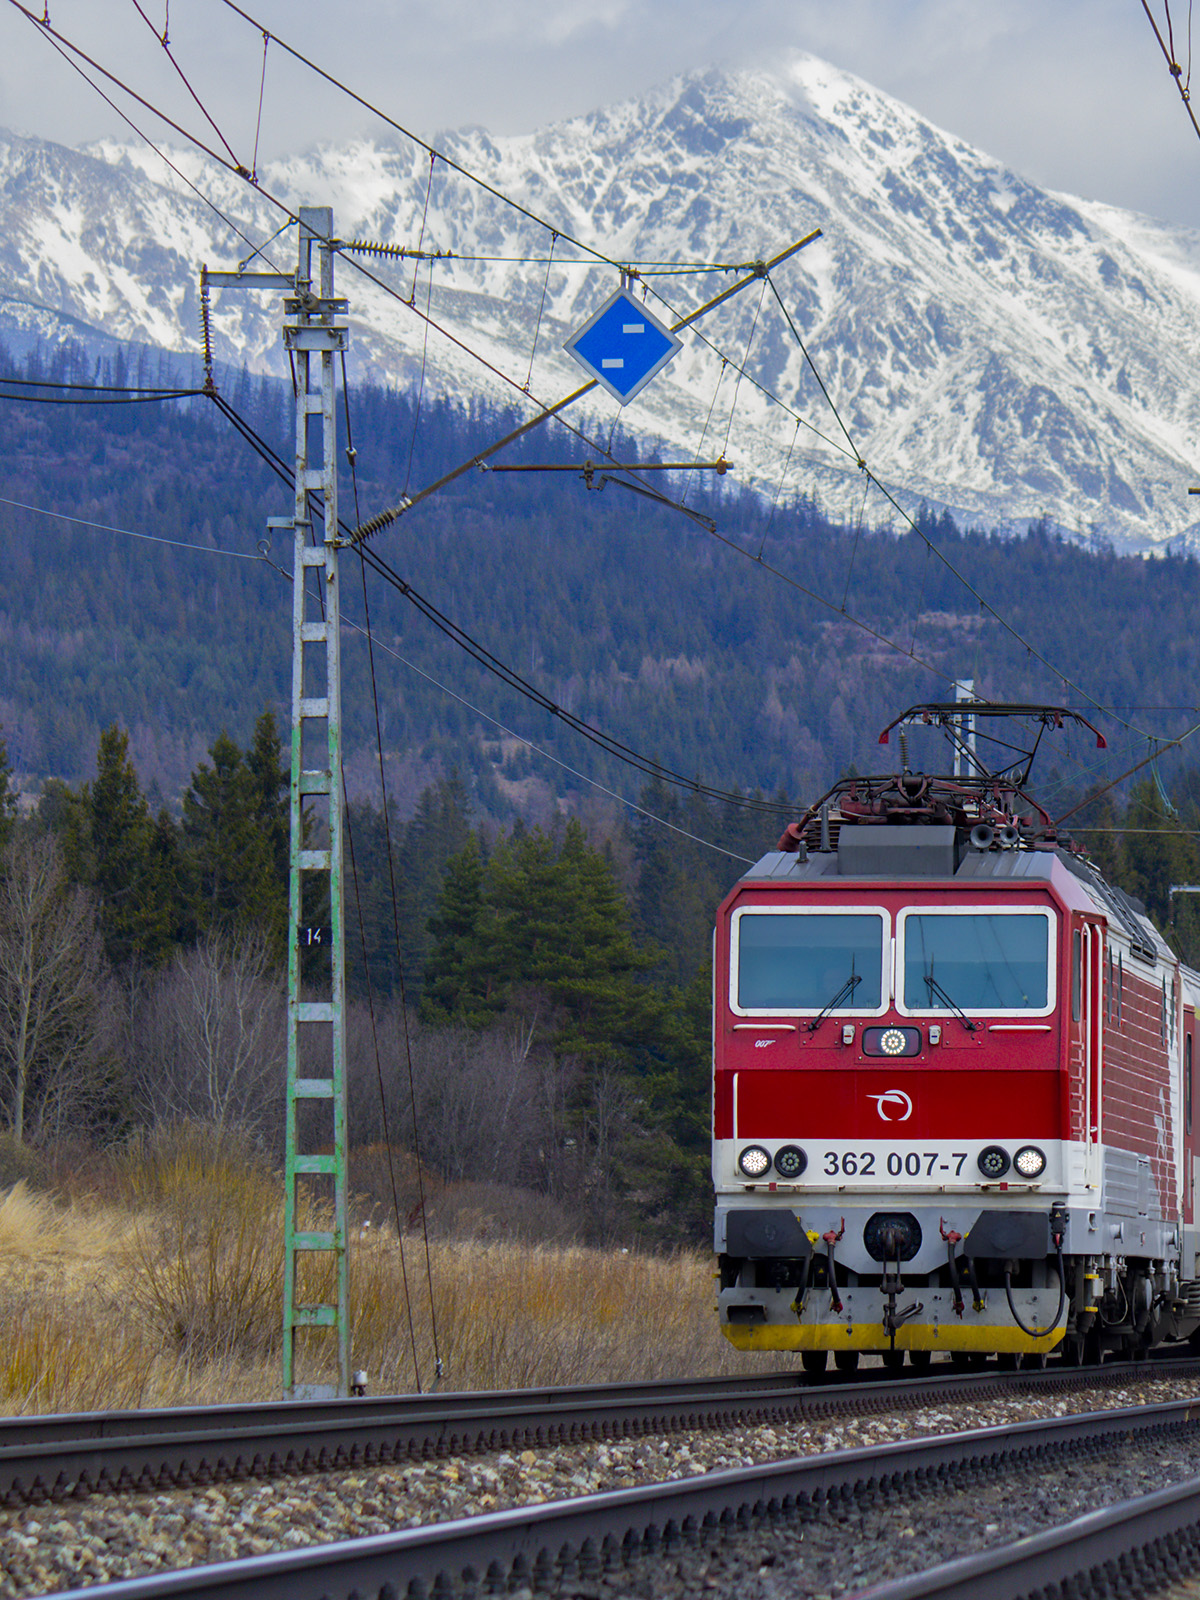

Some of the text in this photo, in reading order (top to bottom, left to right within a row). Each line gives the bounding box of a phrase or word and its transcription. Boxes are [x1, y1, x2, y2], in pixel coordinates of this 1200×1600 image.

[307, 928, 321, 945] 14
[754, 1039, 776, 1048] 007
[823, 1151, 968, 1176] 362 007-7
